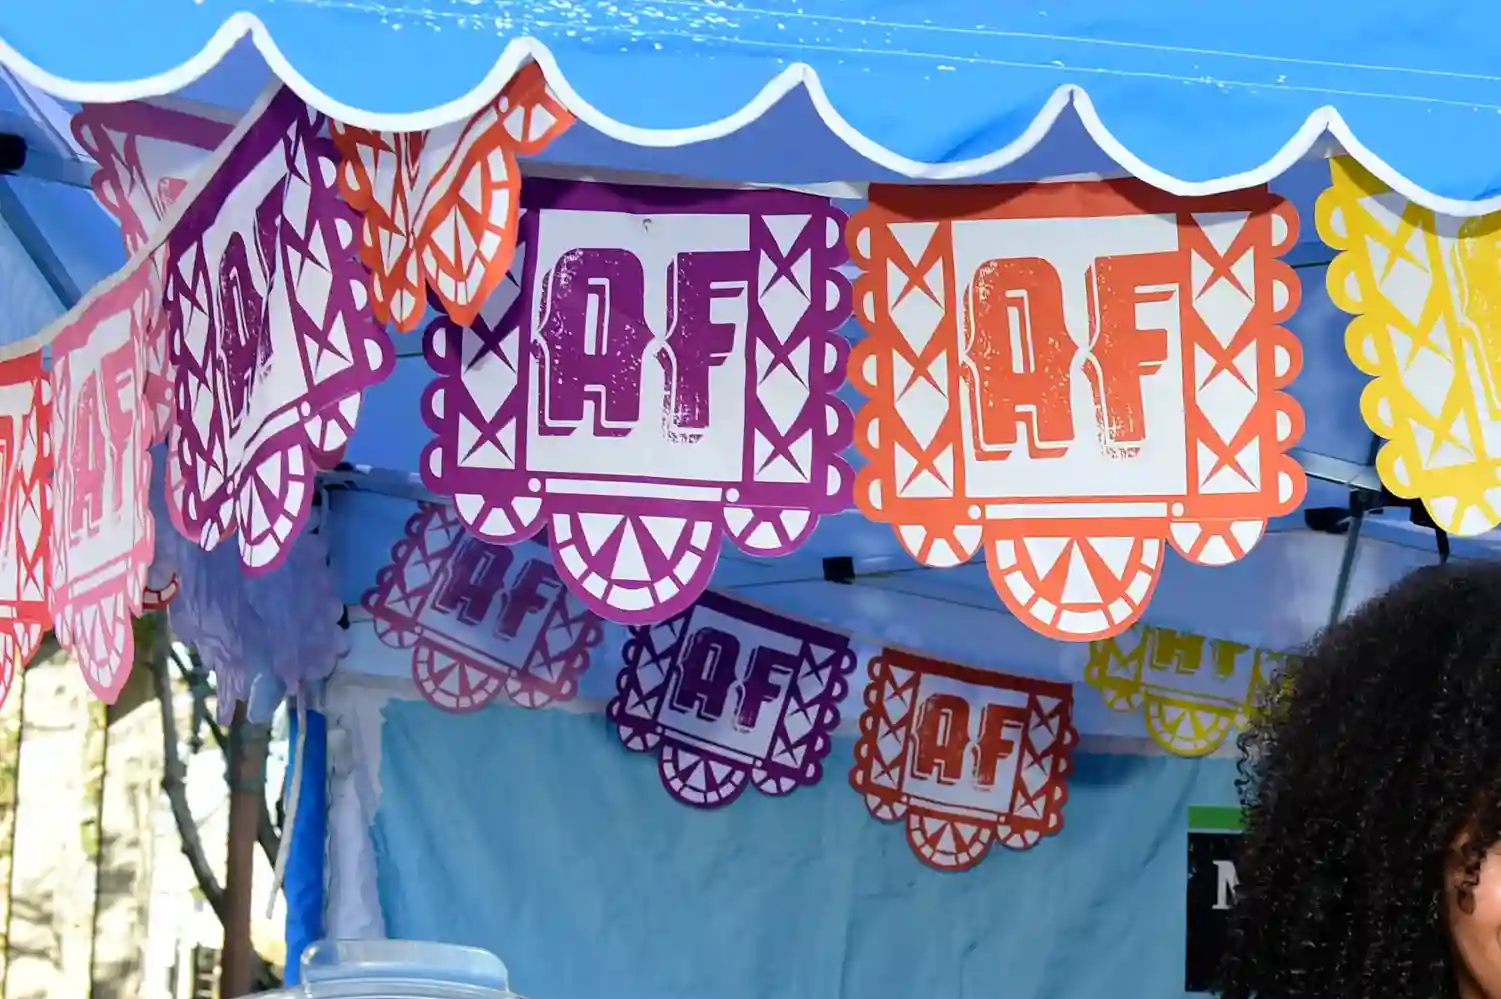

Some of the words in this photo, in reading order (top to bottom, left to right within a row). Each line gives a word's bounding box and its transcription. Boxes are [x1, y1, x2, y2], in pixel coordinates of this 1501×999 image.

[532, 247, 745, 443] AF
[959, 253, 1178, 461] AF
[68, 350, 139, 548] AF
[431, 537, 566, 641] AF
[668, 626, 796, 733] AF
[907, 694, 1028, 791] AF
